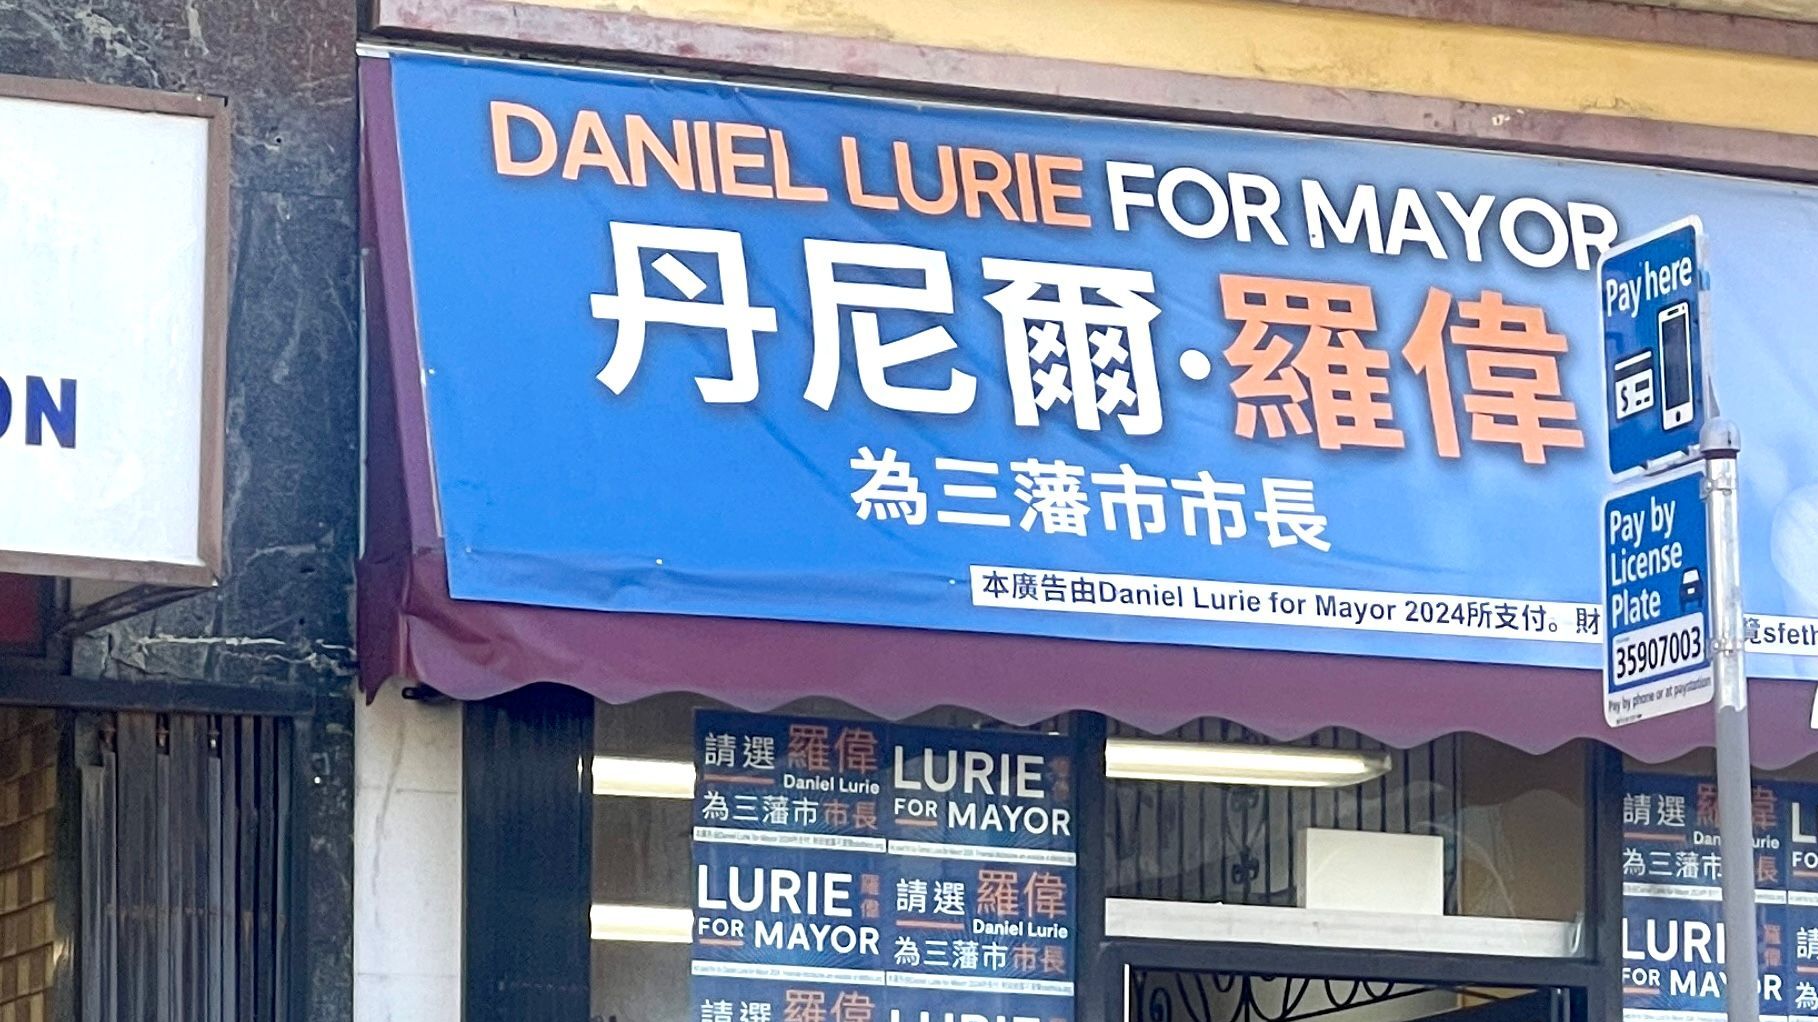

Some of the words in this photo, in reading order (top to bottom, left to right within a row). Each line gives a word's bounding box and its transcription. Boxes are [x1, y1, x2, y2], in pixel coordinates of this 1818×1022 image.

[491, 101, 827, 204] DANIEL
[841, 137, 1093, 231] LURIE
[1104, 160, 1282, 245] FOR
[1302, 185, 1619, 271] MAYOR
[1606, 277, 1642, 318] Pay
[1645, 255, 1692, 296] here
[0, 376, 78, 449] N
[850, 449, 1331, 551] 為三藩市市長
[1610, 506, 1644, 548] Pay
[1651, 495, 1676, 539] by
[1611, 539, 1683, 587] License
[1195, 582, 1261, 613] Lurie
[1266, 592, 1307, 617] for
[1314, 594, 1396, 629] Mayor
[1612, 588, 1661, 629] Plate
[1615, 625, 1702, 680] 35907003
[1609, 700, 1620, 712] Pay
[1622, 696, 1631, 711] by
[1633, 691, 1654, 709] phone
[1657, 690, 1664, 699] or
[1666, 685, 1672, 697] at
[704, 733, 774, 769] 請選
[787, 724, 877, 774] 羅偉
[894, 746, 1044, 798] LURIE
[784, 775, 835, 792] Daniel
[840, 777, 880, 795] Lurie
[702, 792, 877, 829] 為三藩市市長
[895, 799, 938, 817] FOR
[949, 803, 1070, 836] MAYOR
[1622, 847, 1778, 883] 為三藩市長
[698, 865, 852, 917] LURIE
[896, 878, 965, 915] 請選
[976, 869, 1067, 919] 羅偉
[698, 917, 744, 936] FOR
[755, 921, 879, 955] MAYOR
[973, 919, 1023, 936] Daniel
[1028, 922, 1068, 938] Lurie
[1622, 918, 1725, 963] LURI
[895, 937, 1065, 973] 為三藩市市長
[1622, 967, 1660, 986] FOR
[1670, 971, 1782, 1001] MAR
